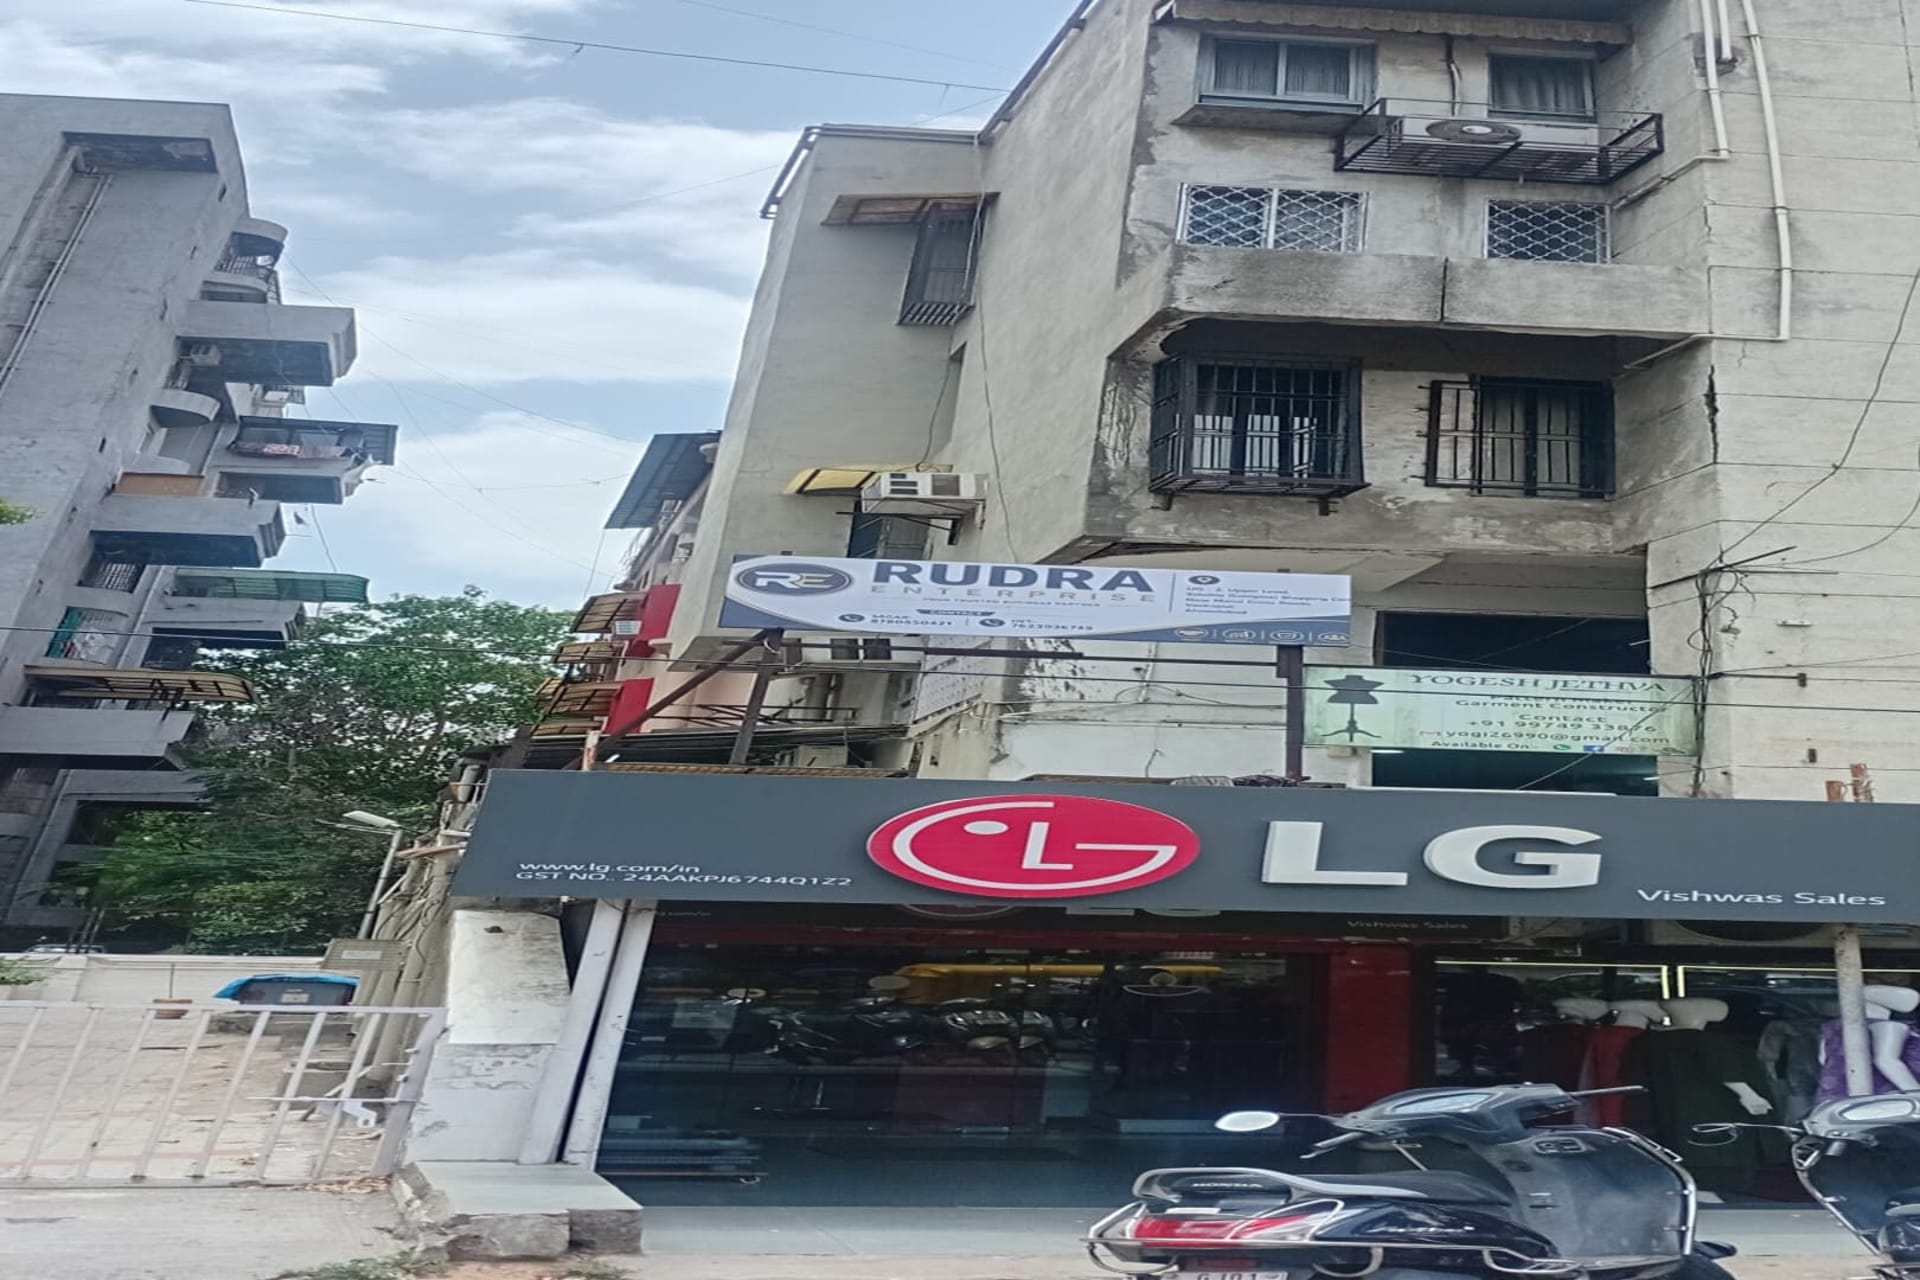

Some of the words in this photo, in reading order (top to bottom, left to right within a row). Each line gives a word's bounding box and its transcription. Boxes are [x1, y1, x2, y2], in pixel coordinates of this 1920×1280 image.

[874, 562, 1154, 593] RUDRA
[871, 585, 1156, 602] ENTERPRISE
[1410, 674, 1539, 688] YOGESH
[1543, 679, 1667, 692] JETHVA
[1455, 700, 1542, 709] Garment
[1549, 703, 1666, 713] Constructor
[1518, 714, 1608, 723] Contact
[1431, 741, 1502, 749] Available
[1261, 819, 1603, 889] LG
[518, 863, 701, 873] www.lg.com/in
[515, 871, 563, 880] GST
[623, 873, 852, 886] 24AAKPJ6744Q1Z2
[1637, 889, 1784, 904] Vishwas
[1793, 892, 1887, 905] Sales
